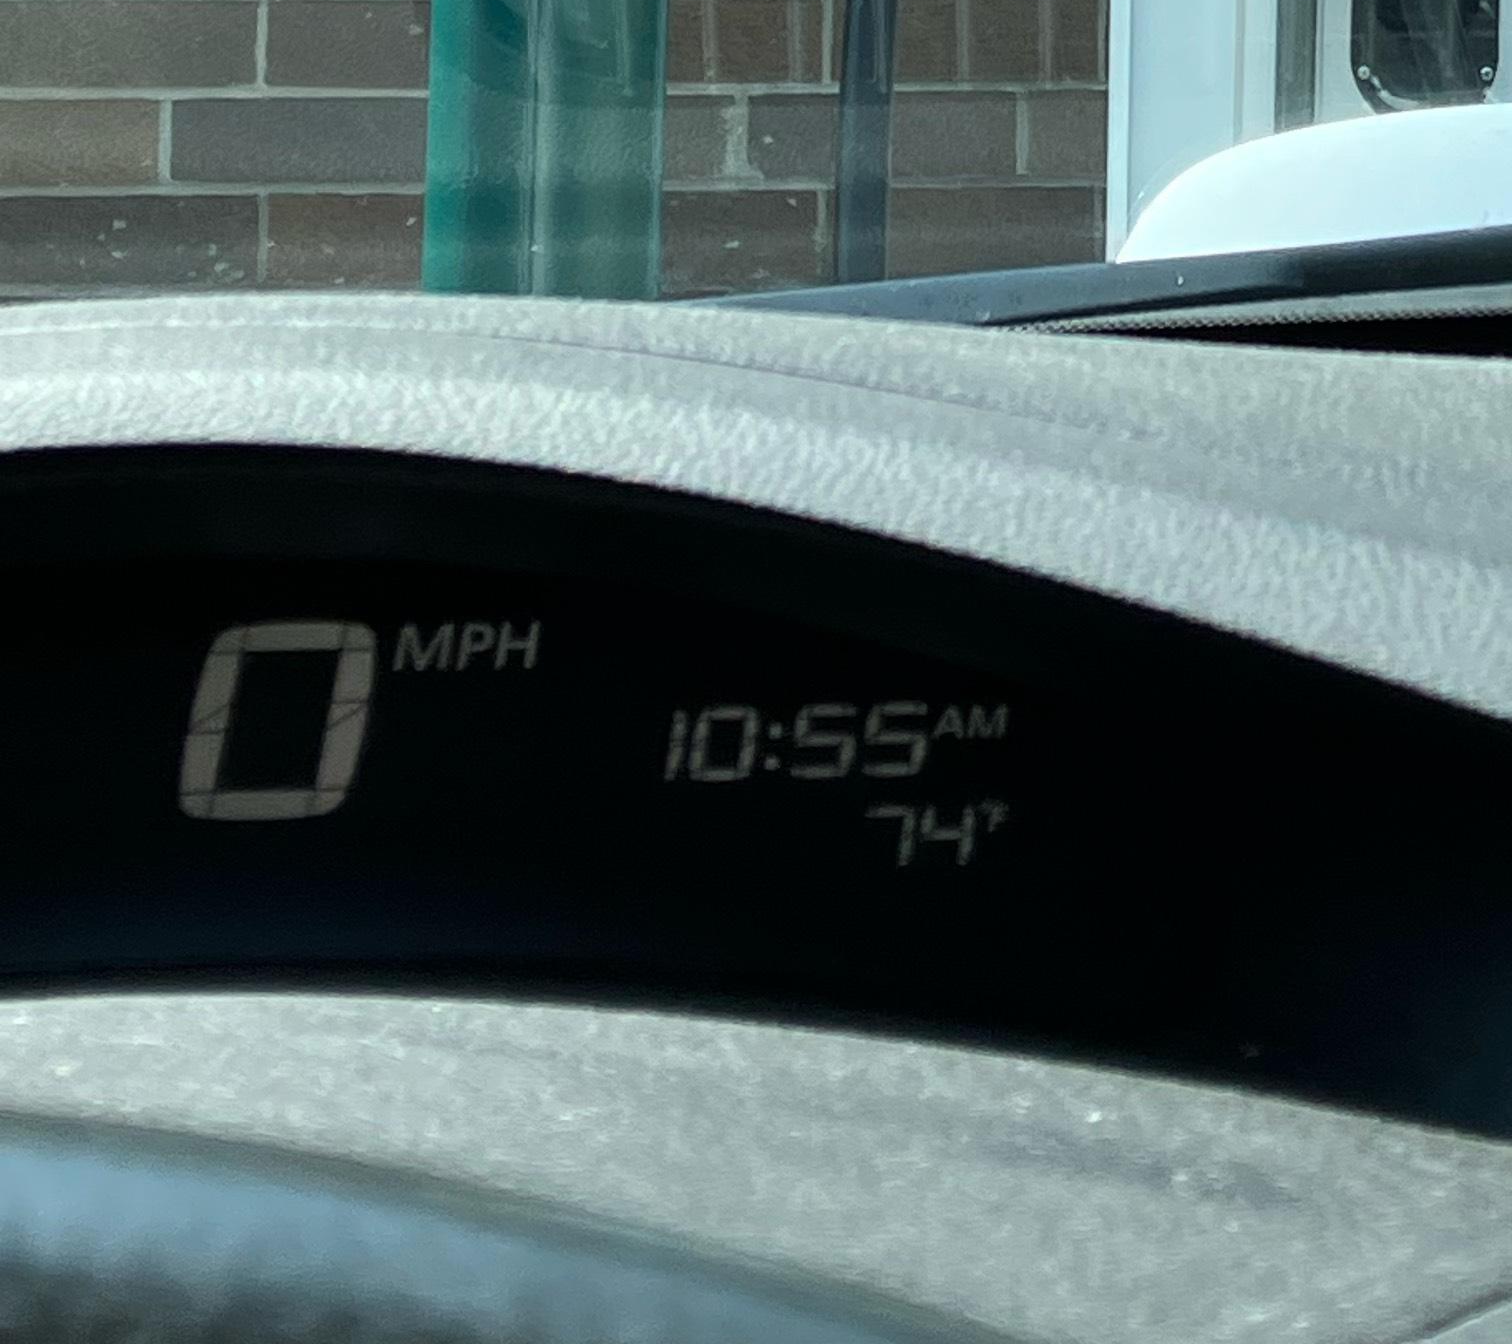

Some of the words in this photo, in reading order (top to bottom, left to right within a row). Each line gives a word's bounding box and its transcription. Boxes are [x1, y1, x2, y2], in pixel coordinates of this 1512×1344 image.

[178, 620, 378, 822] 0
[392, 620, 543, 673] MPH
[664, 700, 929, 783] 10:55
[933, 703, 1010, 740] AM
